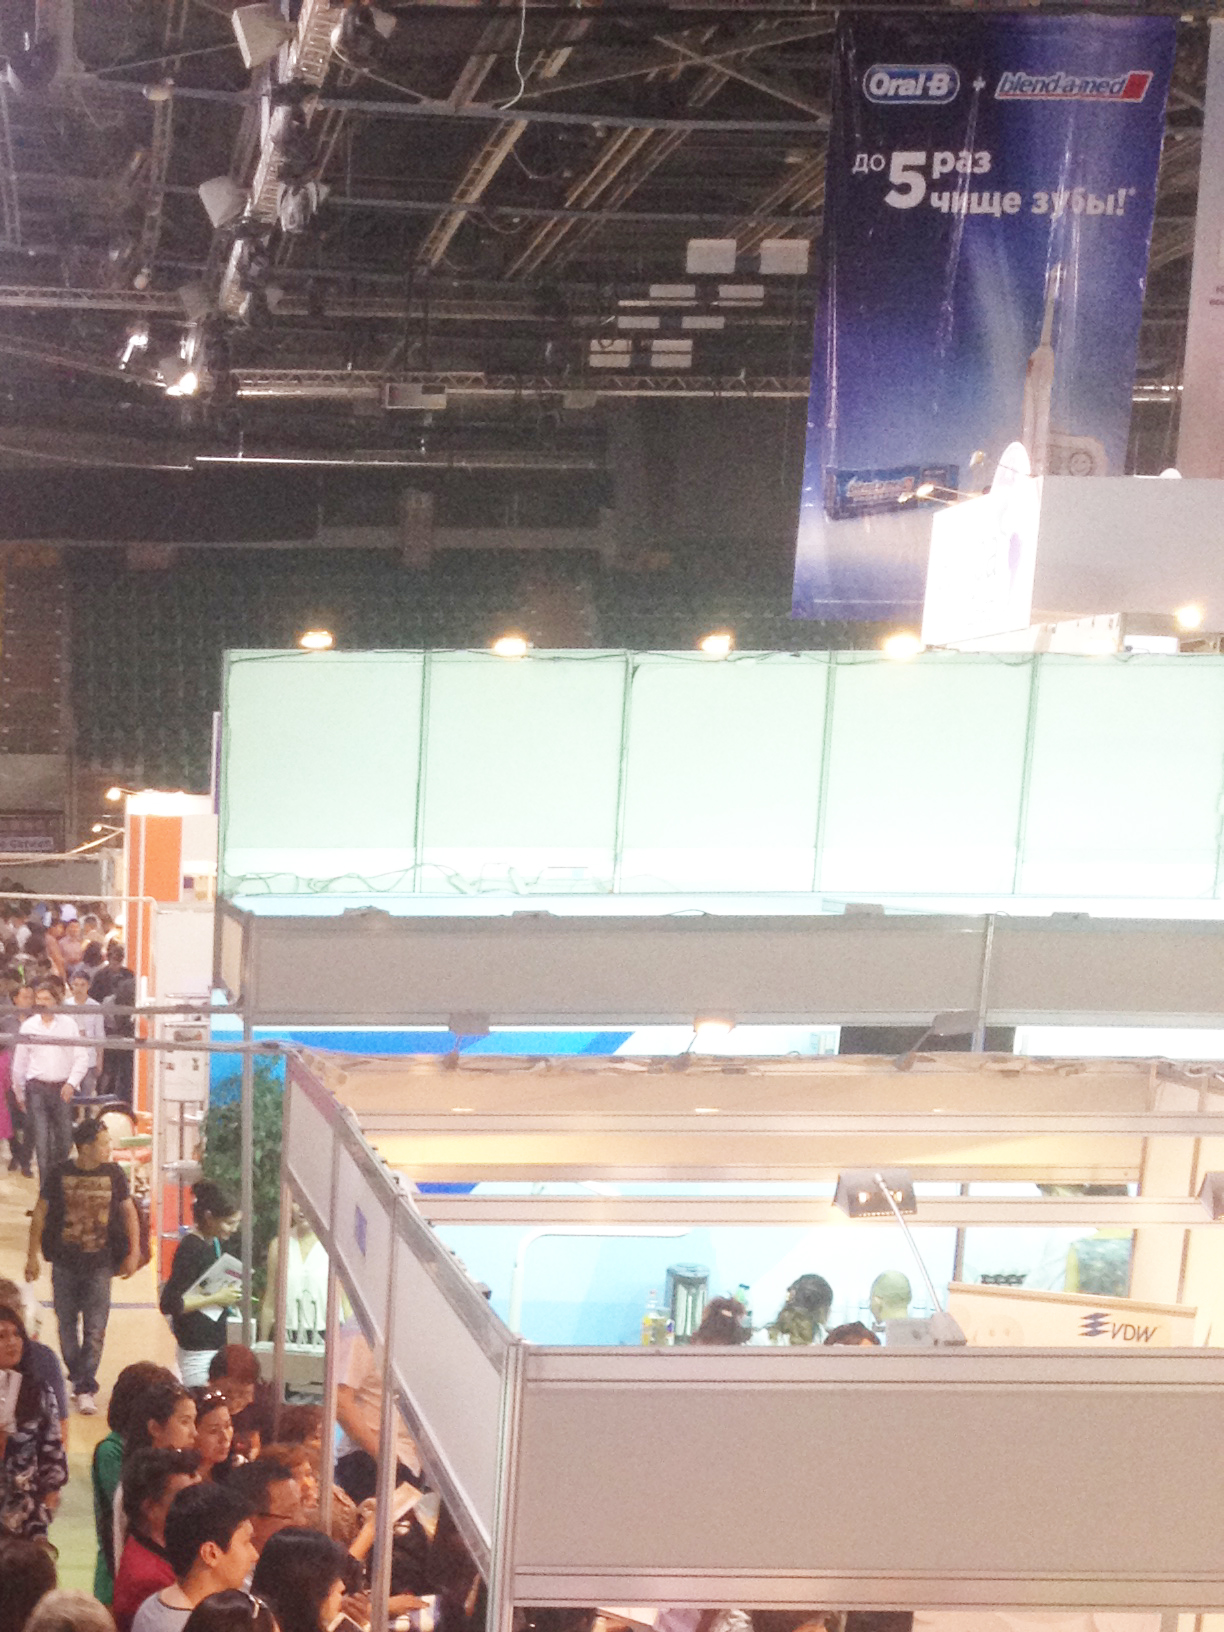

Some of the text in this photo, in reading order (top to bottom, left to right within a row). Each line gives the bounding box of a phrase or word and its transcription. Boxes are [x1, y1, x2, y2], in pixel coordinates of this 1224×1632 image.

[869, 71, 1125, 96] Oral-B blend-a-med
[851, 150, 992, 209] до 5 раз
[930, 191, 1022, 218] чище
[1111, 1322, 1159, 1343] VDW
